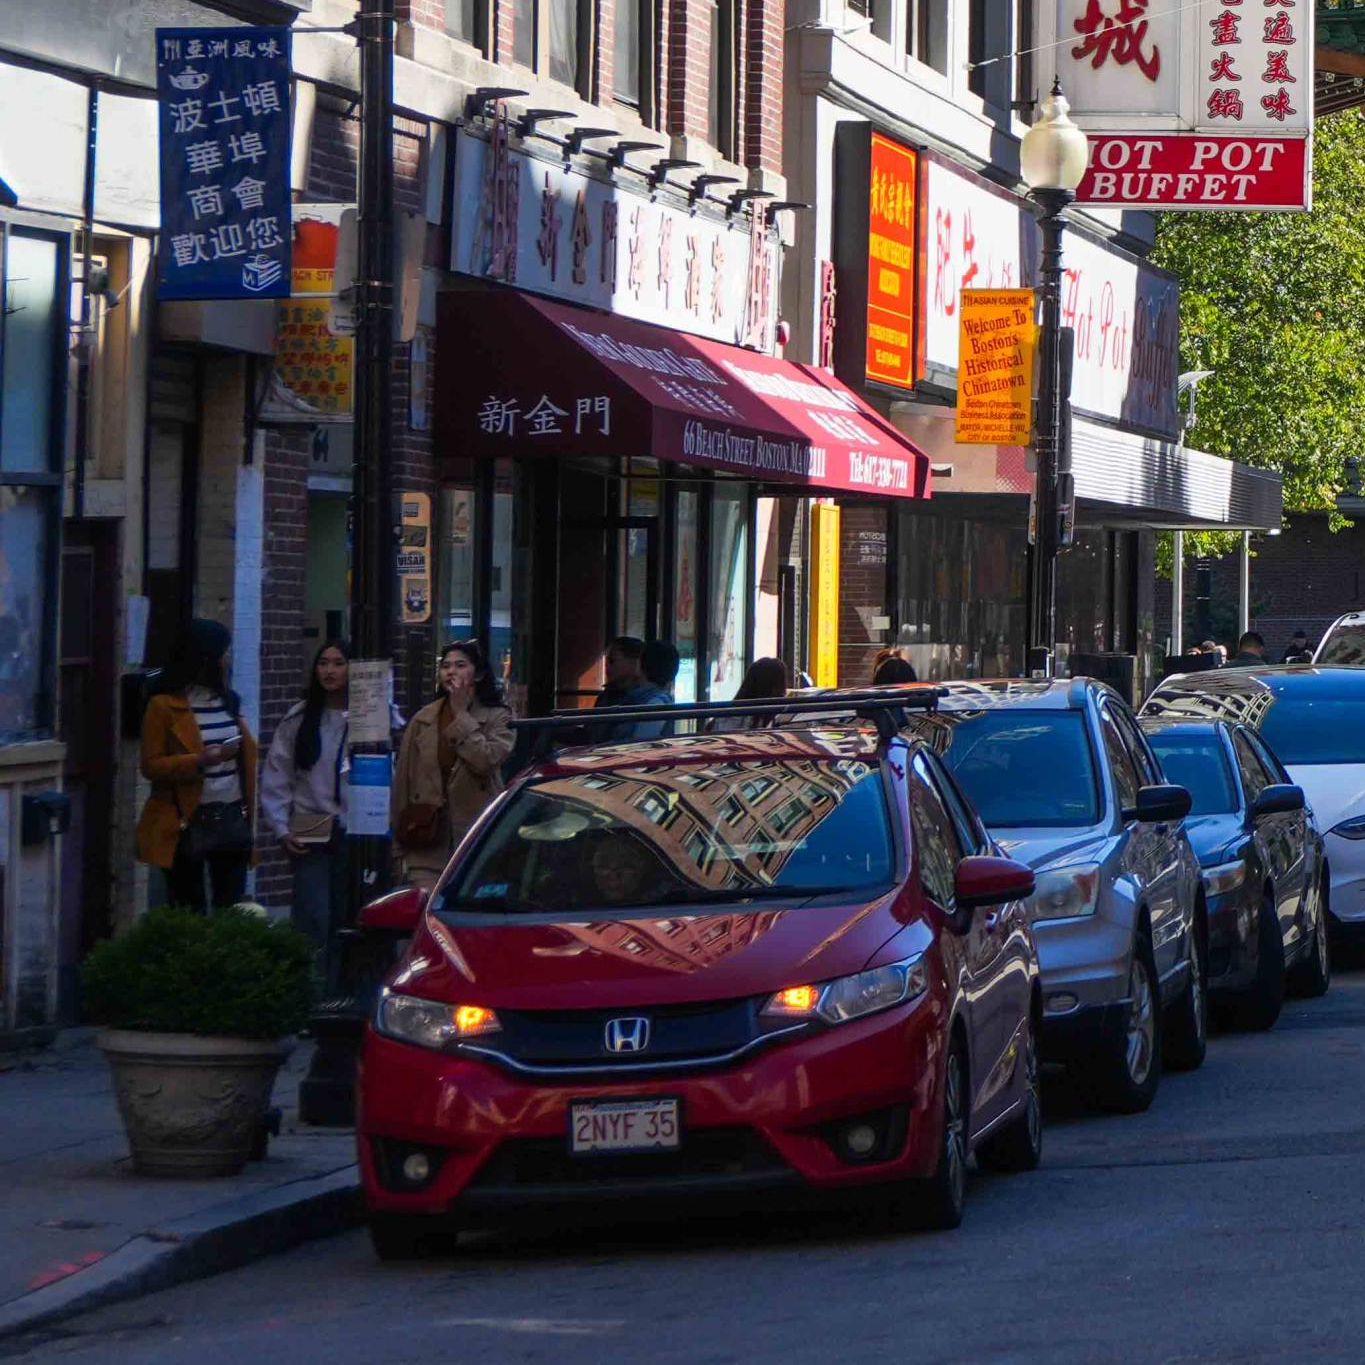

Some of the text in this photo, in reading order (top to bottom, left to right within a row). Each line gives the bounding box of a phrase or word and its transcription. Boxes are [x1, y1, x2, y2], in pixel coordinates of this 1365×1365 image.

[184, 38, 282, 60] 亞洲風味
[169, 80, 283, 134] 波士頓
[185, 131, 267, 175] 華埠
[1190, 141, 1285, 171] POT
[187, 175, 266, 220] 商會
[1090, 172, 1257, 201] BUFFET
[170, 216, 284, 268] 歡迎您
[973, 297, 997, 306] ASIAN
[963, 308, 1027, 336] Welcome To
[1099, 281, 1128, 372] Pot
[964, 349, 1024, 376] Historical
[962, 374, 1026, 397] Chinatown
[477, 395, 611, 436] 新金門
[683, 418, 695, 445] 66
[576, 1110, 675, 1143] 2NYF 35
